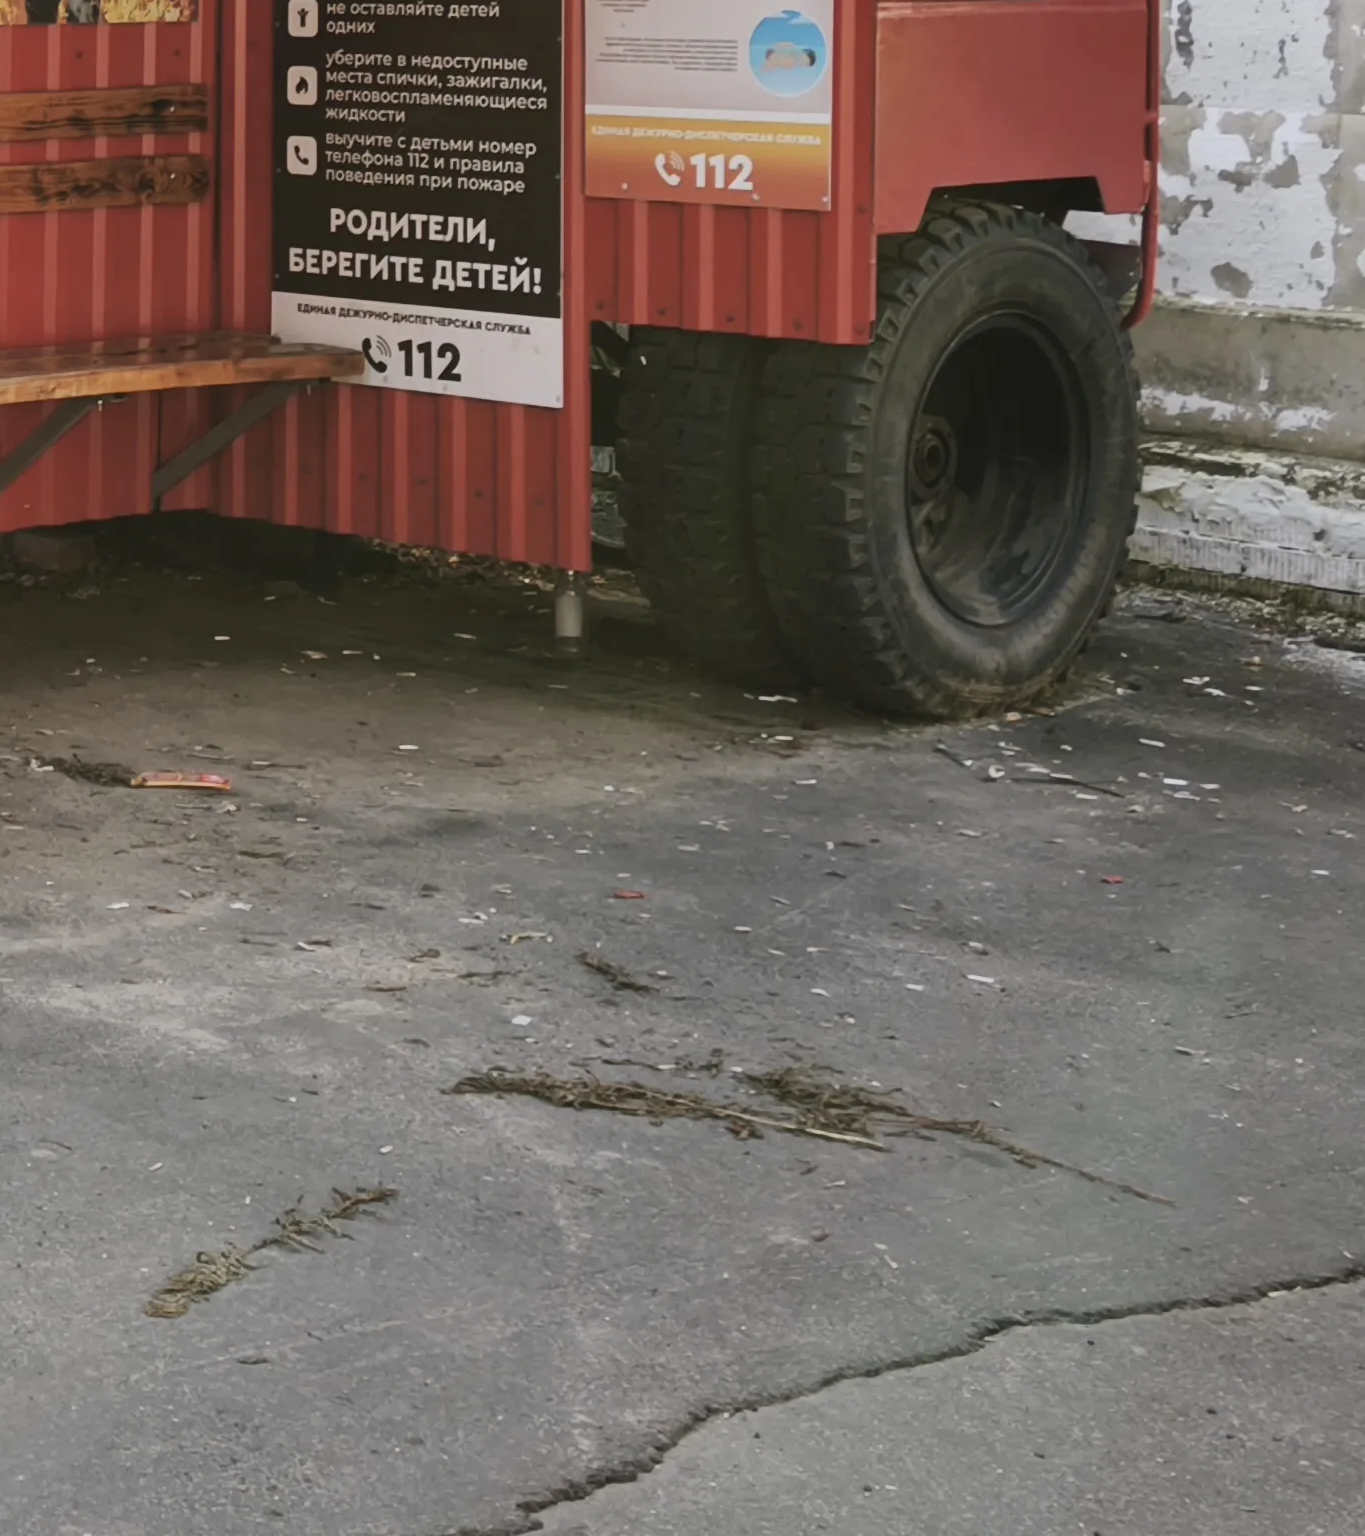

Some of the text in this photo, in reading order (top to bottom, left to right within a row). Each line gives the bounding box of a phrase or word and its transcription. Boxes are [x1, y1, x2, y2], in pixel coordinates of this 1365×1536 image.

[326, 0, 500, 18] не оставляйте детей
[326, 20, 376, 34] одних
[325, 49, 528, 73] уберите в недоступные
[325, 70, 548, 93] места спички, зажигалки,
[325, 88, 548, 111] легковоспламеняющиеся
[325, 107, 406, 123] жидкости
[326, 133, 537, 158] выучите с детьми номер
[325, 150, 525, 174] телефона 112 и правила
[690, 153, 753, 191] 112
[326, 169, 526, 195] поведения при пожаре
[329, 208, 496, 252] РОДИТЕЛИ,
[289, 247, 542, 294] БЕРЕГИТЕ ДЕТЕЙ!
[297, 303, 531, 335] ЕДИНАЯ ДЕЖУРНО-ДИСПЕТЧЕРСКАЯ СЛУЖБА
[397, 339, 462, 382] 112
